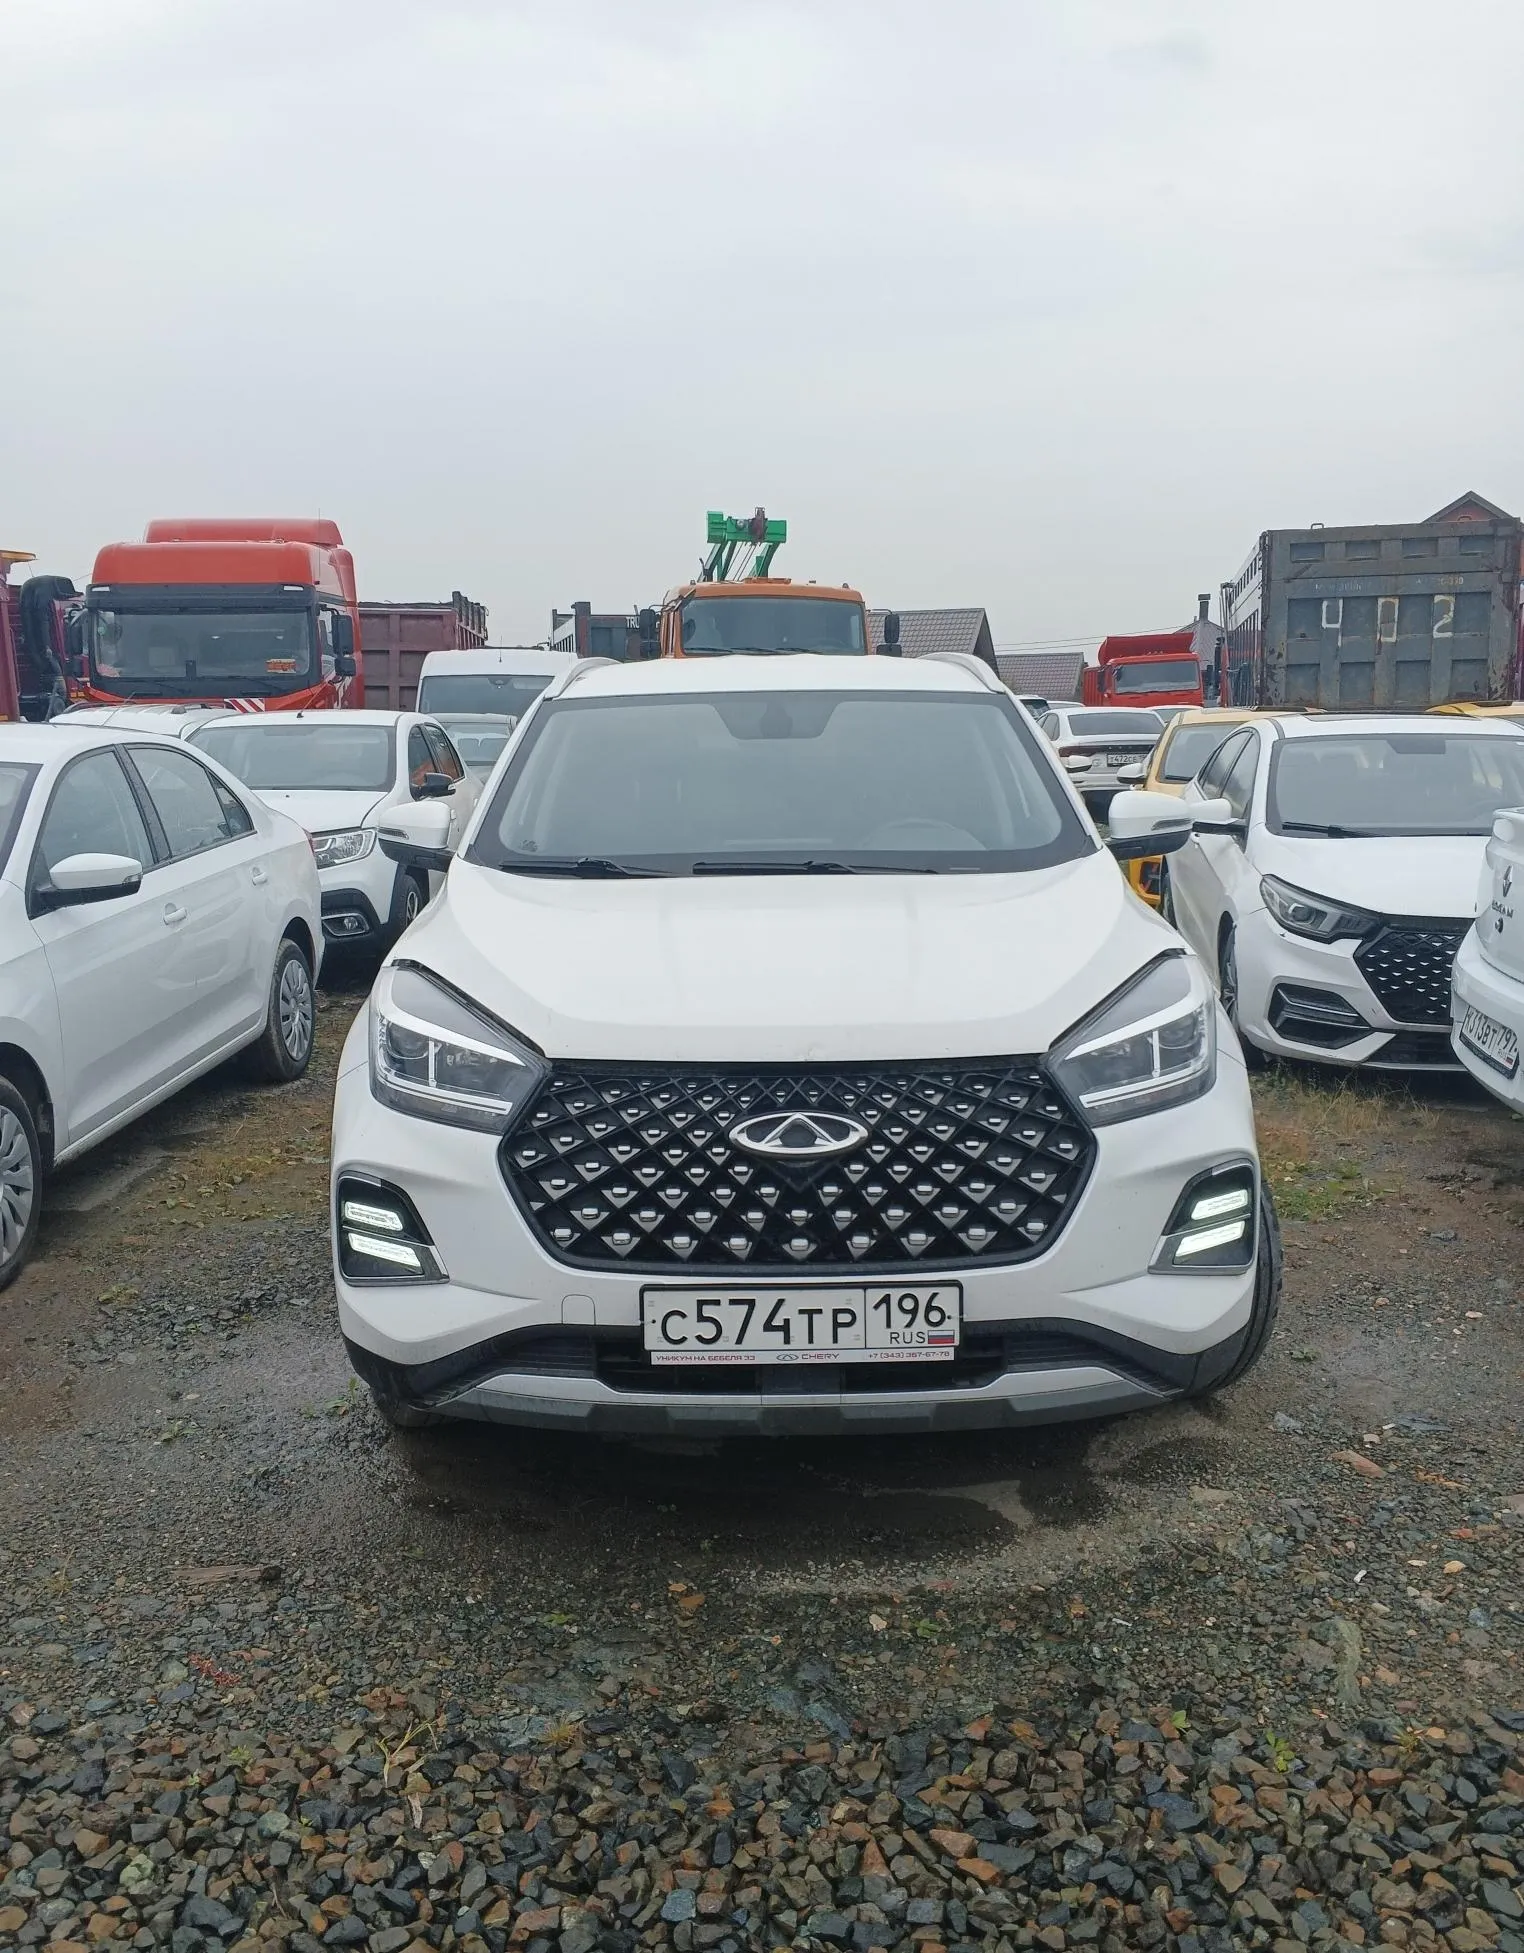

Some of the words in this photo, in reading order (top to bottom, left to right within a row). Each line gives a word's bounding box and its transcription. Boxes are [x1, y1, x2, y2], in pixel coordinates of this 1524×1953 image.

[626, 616, 640, 629] TRU
[660, 1298, 858, 1345] С574ТР
[872, 1292, 946, 1329] 196
[889, 1331, 926, 1345] RUS
[880, 1351, 905, 1359] (343)
